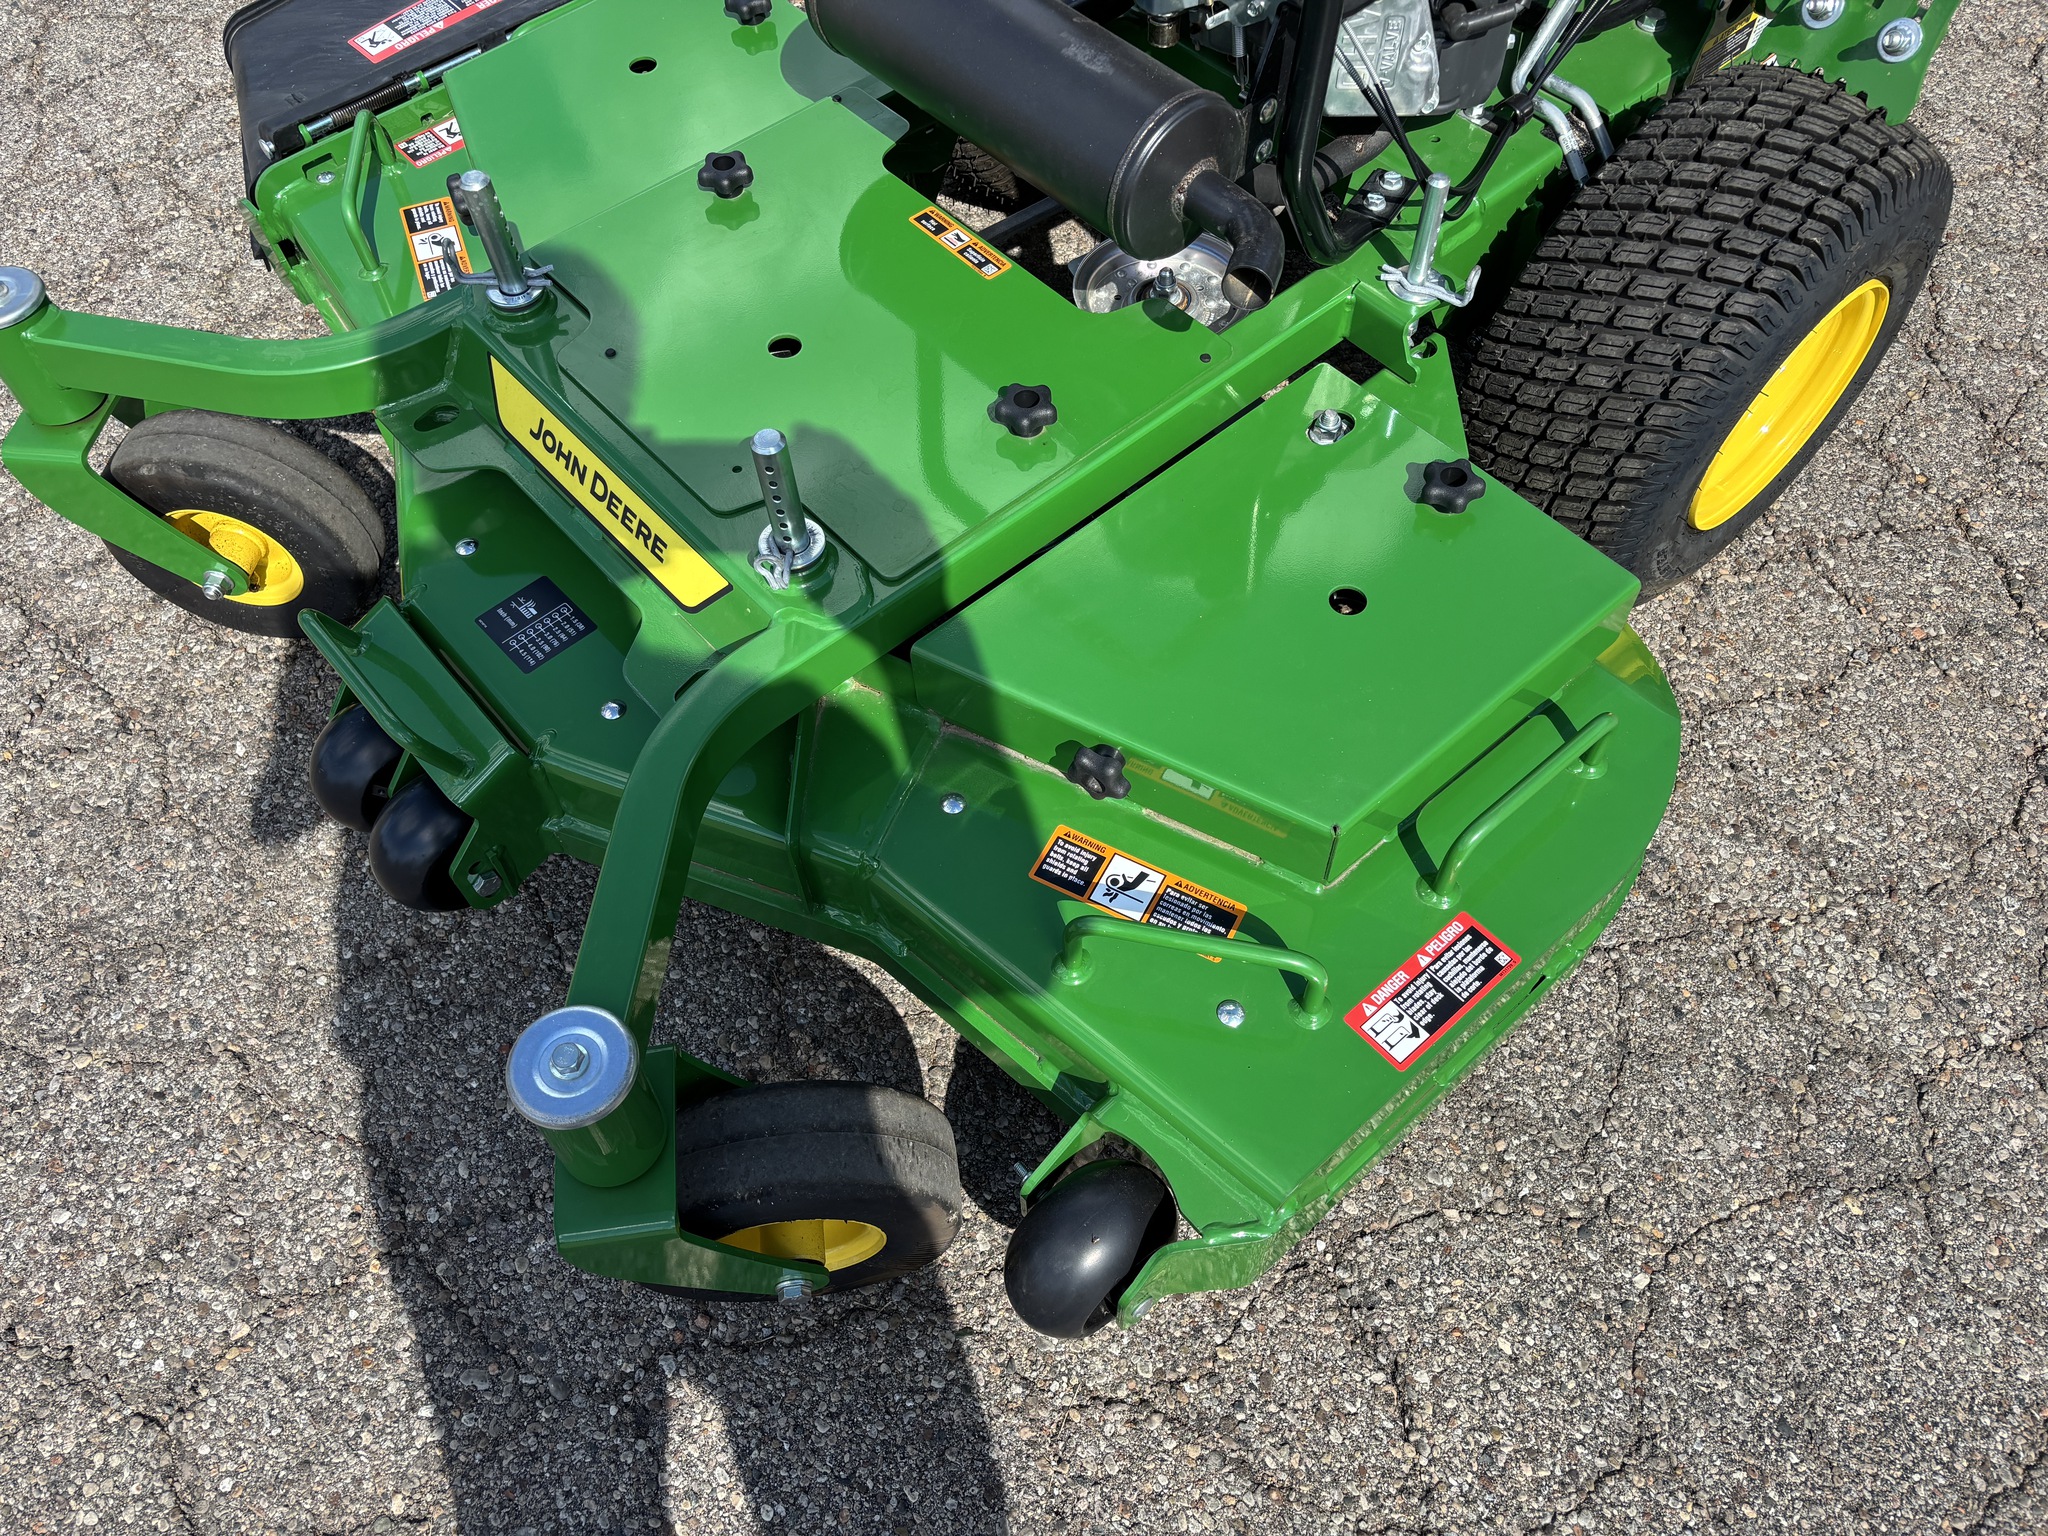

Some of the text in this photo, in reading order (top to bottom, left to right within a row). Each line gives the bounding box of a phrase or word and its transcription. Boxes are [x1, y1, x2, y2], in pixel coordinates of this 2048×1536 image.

[393, 26, 436, 50] PELIGRO
[529, 417, 668, 563] JOHN DEERE
[1063, 842, 1080, 853] avoid
[1078, 849, 1097, 862] injury
[1070, 833, 1107, 853] WARNING
[1045, 856, 1078, 875] shields and
[1052, 845, 1089, 865] from rotating
[1064, 858, 1080, 869] keep
[1079, 864, 1089, 872] all
[1041, 862, 1062, 876] guards
[1159, 900, 1181, 913] correas
[1162, 893, 1213, 919] lesionado por las
[1165, 887, 1208, 910] Para evitar ser
[1182, 882, 1237, 911] ADVERTENCIA
[1155, 905, 1184, 921] mantener
[1184, 917, 1202, 929] todos
[1201, 925, 1212, 934] los
[1424, 920, 1465, 956] PELIGRO
[1428, 959, 1443, 972] Para
[1438, 948, 1455, 963] evitar
[1455, 950, 1467, 960] por
[1463, 962, 1475, 973] del
[1471, 950, 1488, 966] borde
[1483, 945, 1494, 954] de
[1370, 969, 1410, 1005] DANGER
[1392, 971, 1431, 1005] To avoid injury
[1399, 980, 1433, 1010] from rotating
[1423, 987, 1438, 1000] stay
[1459, 989, 1470, 998] de
[1411, 991, 1444, 1021] clear of deck
[1418, 1010, 1436, 1027] edge.
